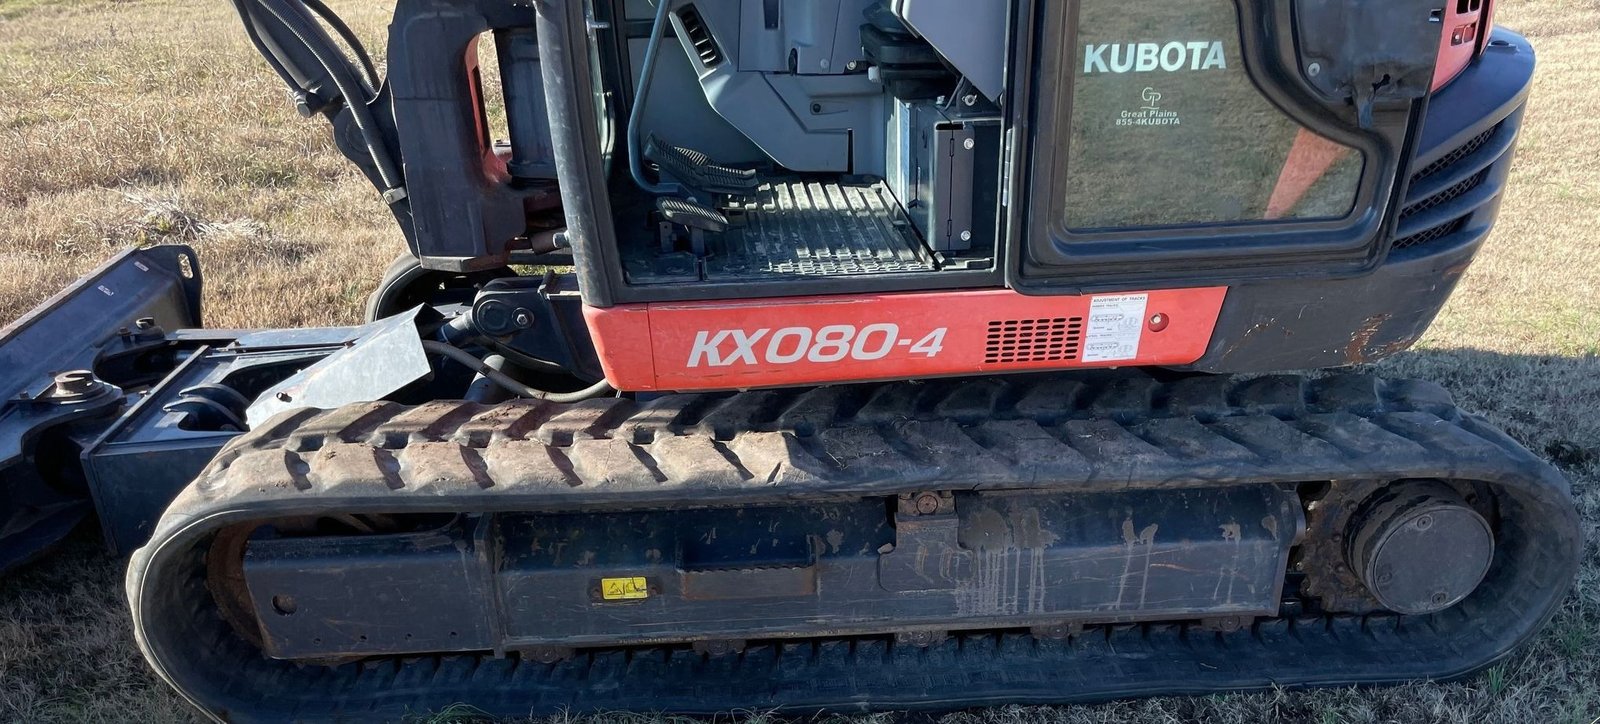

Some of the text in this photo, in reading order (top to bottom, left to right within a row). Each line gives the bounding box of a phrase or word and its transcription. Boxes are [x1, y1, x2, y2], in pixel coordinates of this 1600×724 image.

[1084, 41, 1226, 73] KUBOTA
[1115, 117, 1180, 126] 855-4KUBOTA
[1121, 110, 1147, 118] Great
[687, 323, 947, 368] KX080-4
